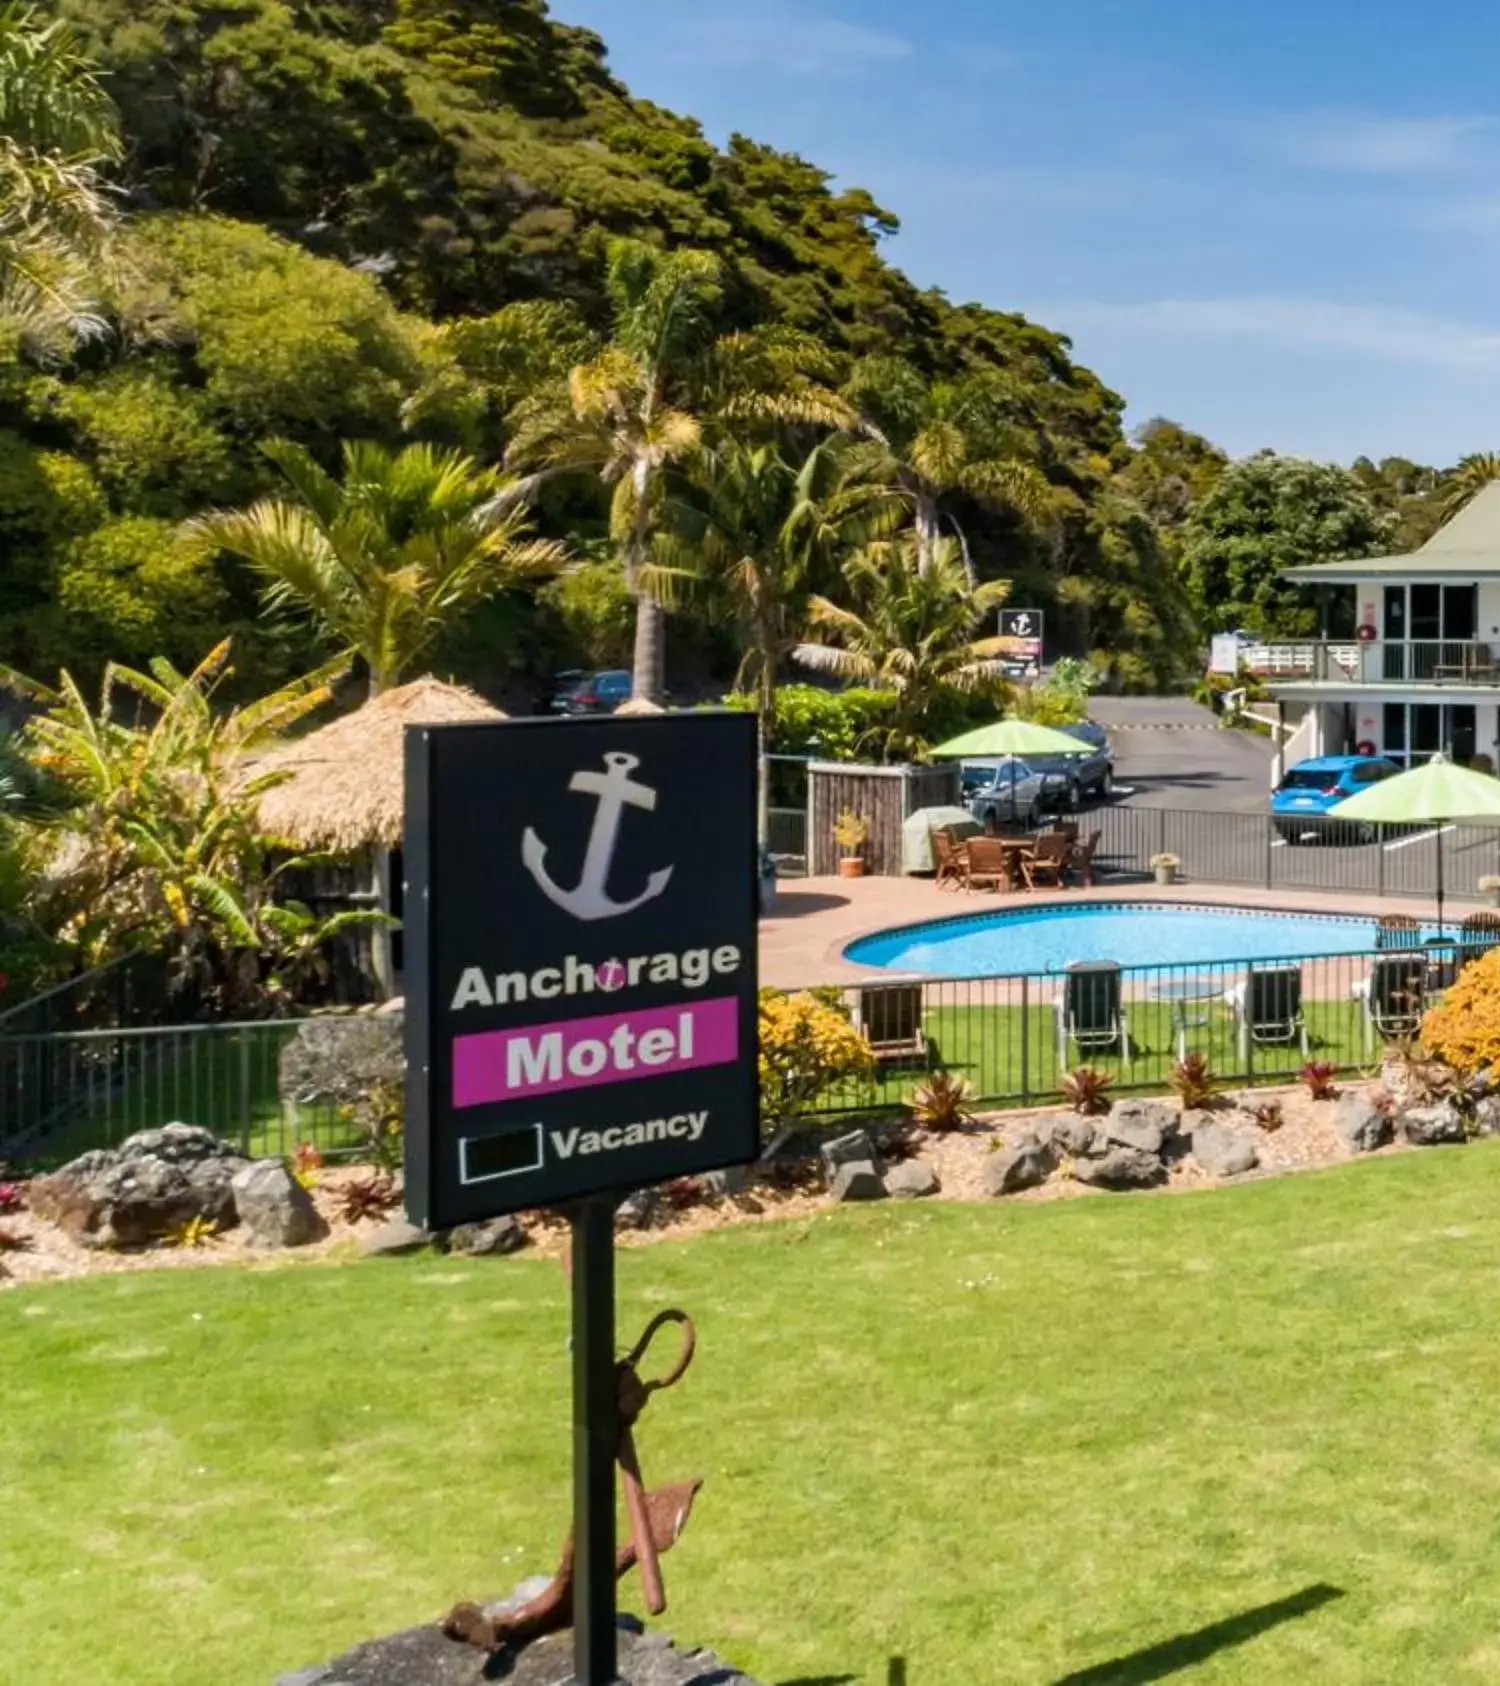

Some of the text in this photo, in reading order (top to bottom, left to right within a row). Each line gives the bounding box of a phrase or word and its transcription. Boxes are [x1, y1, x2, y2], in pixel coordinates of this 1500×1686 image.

[452, 946, 740, 1009] Anchorage
[507, 1013, 693, 1088] Motel
[552, 1112, 707, 1158] Vacancy
